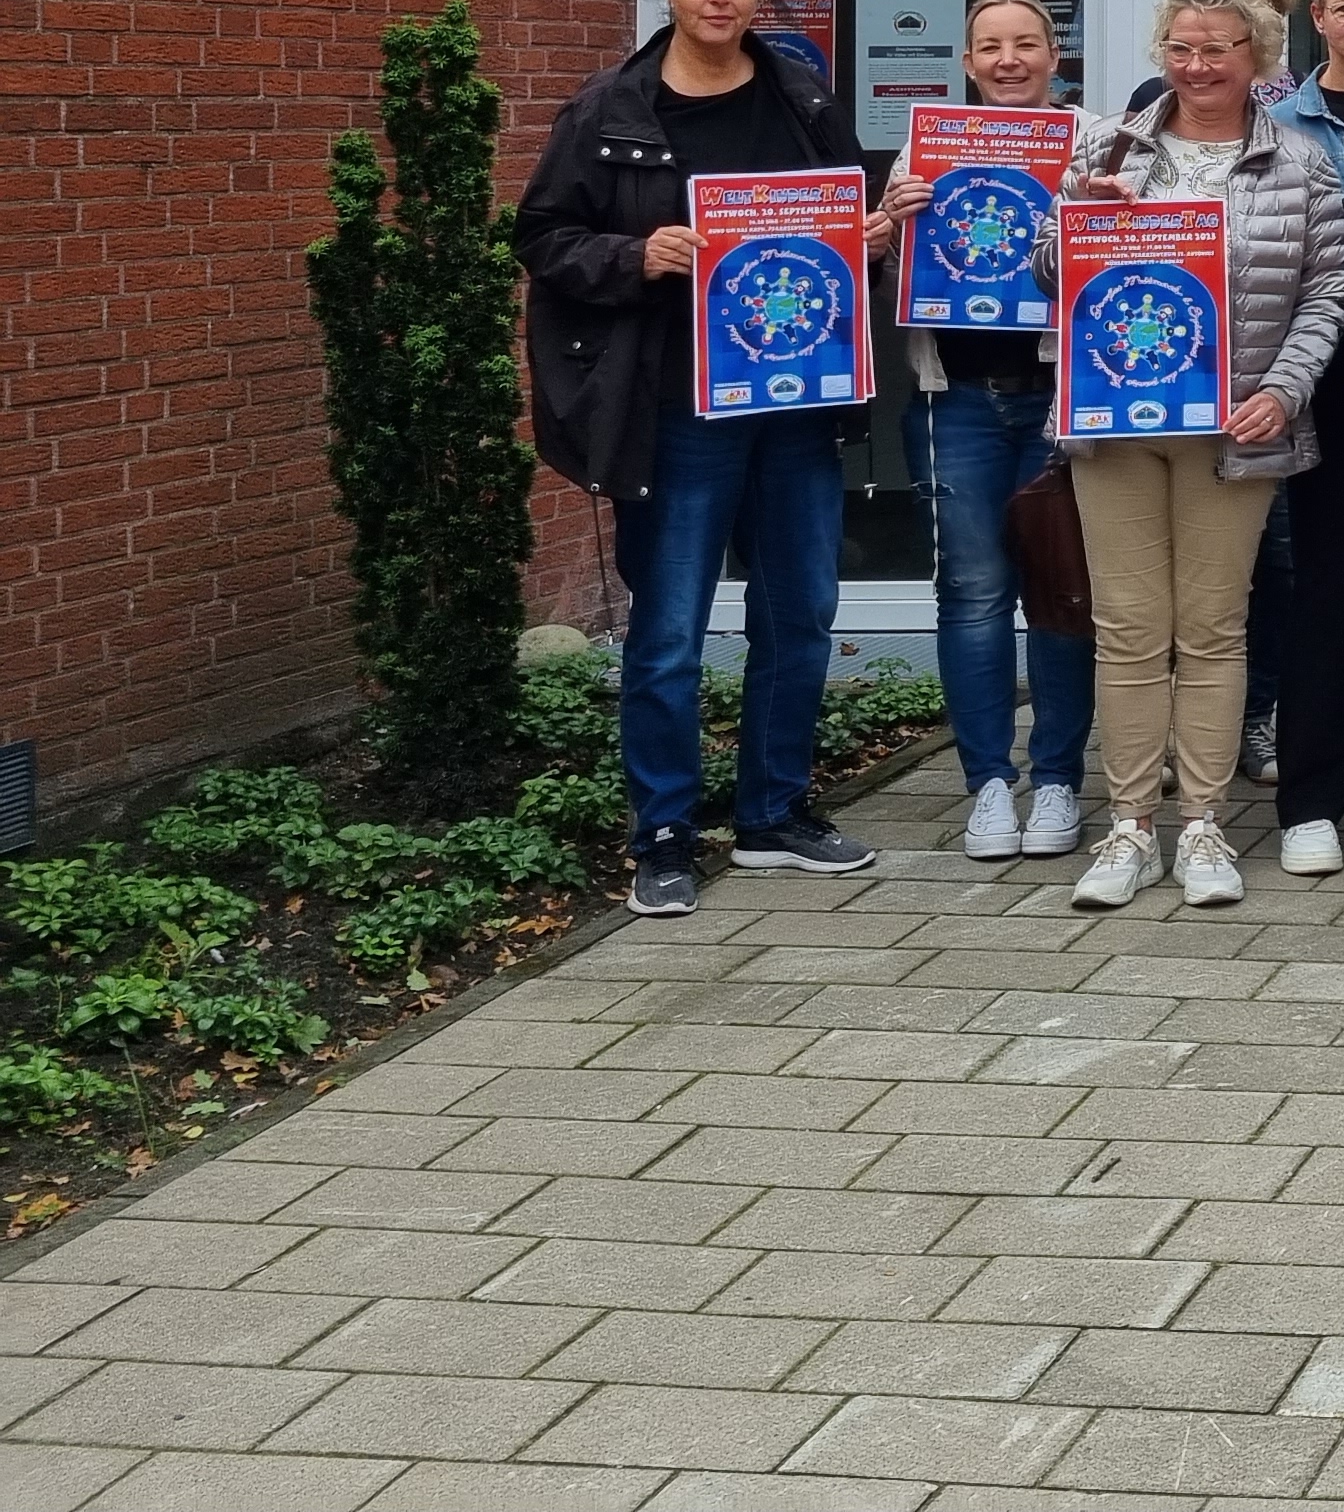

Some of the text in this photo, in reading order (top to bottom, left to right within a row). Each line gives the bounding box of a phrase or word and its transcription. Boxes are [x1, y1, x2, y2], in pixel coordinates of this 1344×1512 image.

[990, 139, 1041, 148] SEPTEMBER
[779, 205, 831, 215] SEPTEMBER
[1141, 232, 1192, 241] SEPTEMBER
